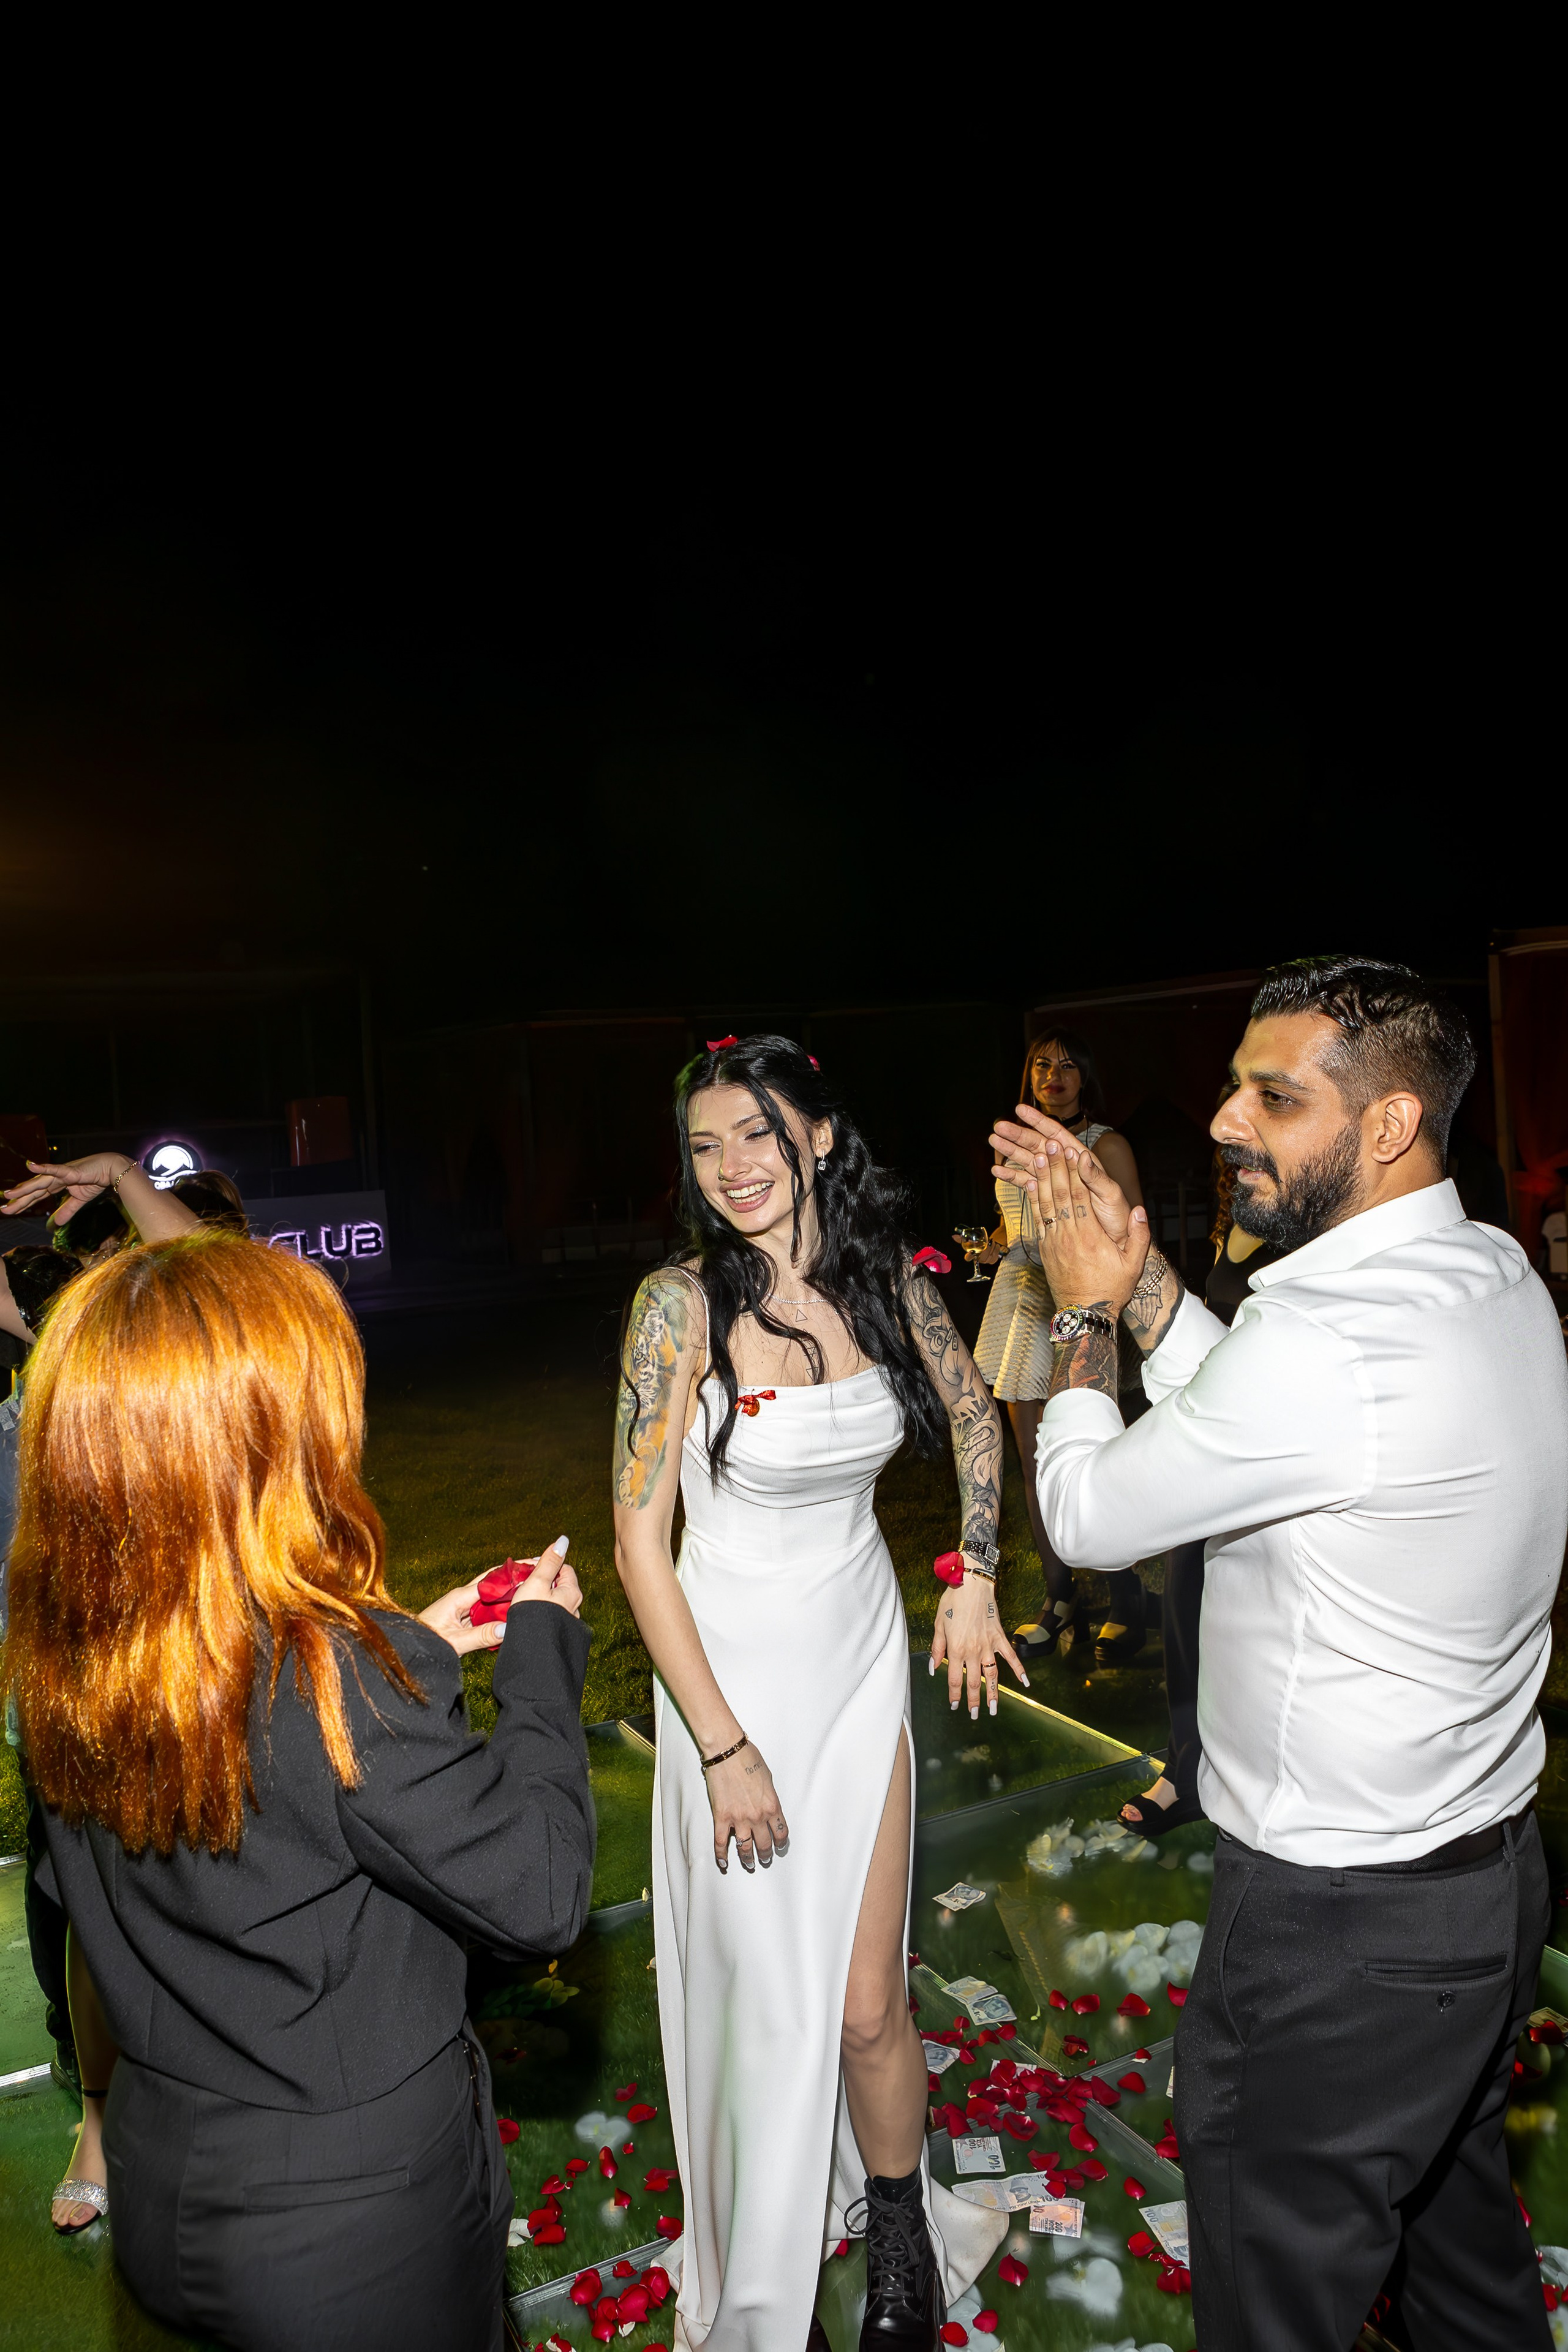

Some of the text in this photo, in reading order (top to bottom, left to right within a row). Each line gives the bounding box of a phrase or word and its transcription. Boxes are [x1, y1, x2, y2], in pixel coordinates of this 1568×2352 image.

[987, 1602, 995, 1614] am
[968, 2139, 977, 2150] 100
[988, 2154, 1001, 2169] 100
[1144, 2208, 1159, 2223] 100
